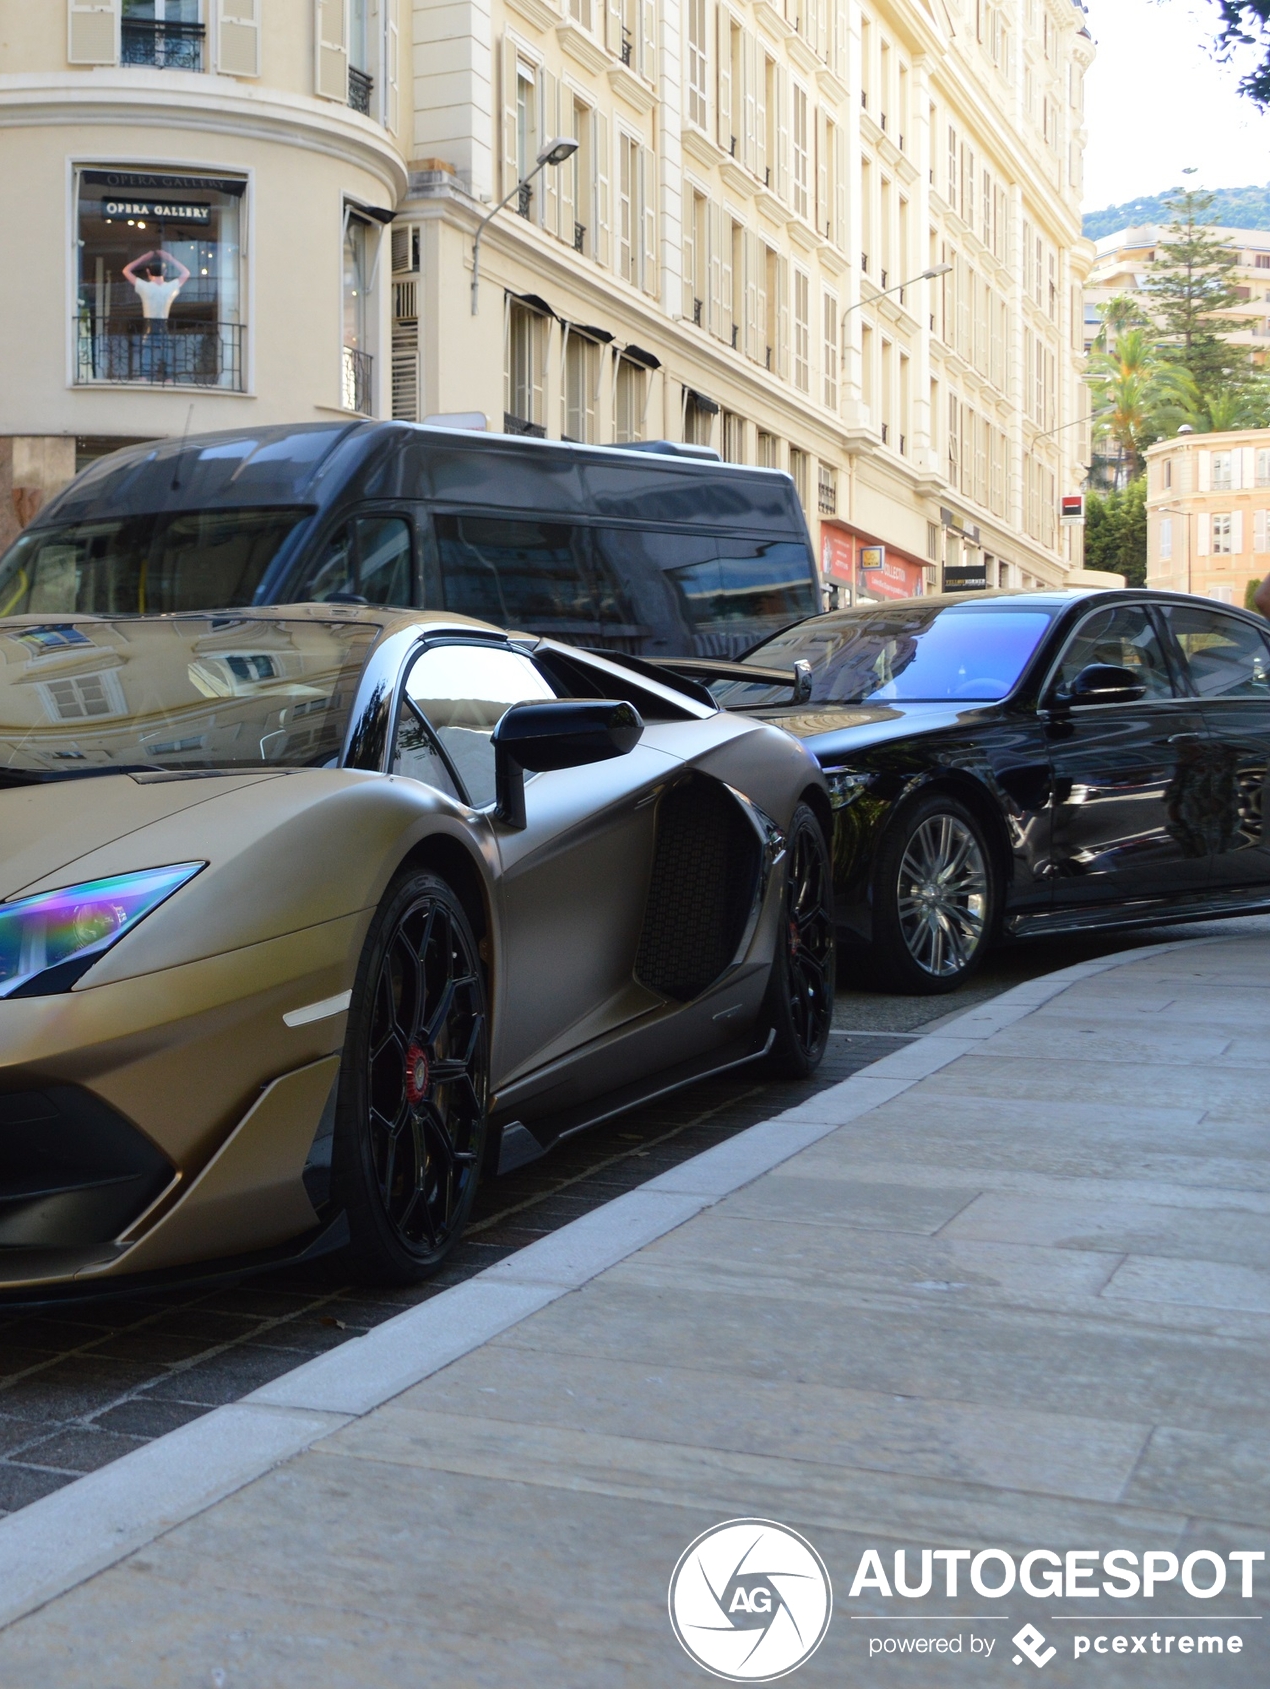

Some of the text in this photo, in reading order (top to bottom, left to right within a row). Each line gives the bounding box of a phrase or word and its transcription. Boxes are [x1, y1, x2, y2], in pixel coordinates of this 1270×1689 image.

[107, 174, 225, 189] OPERA GALLERY
[106, 203, 209, 218] OPERA GALLERY
